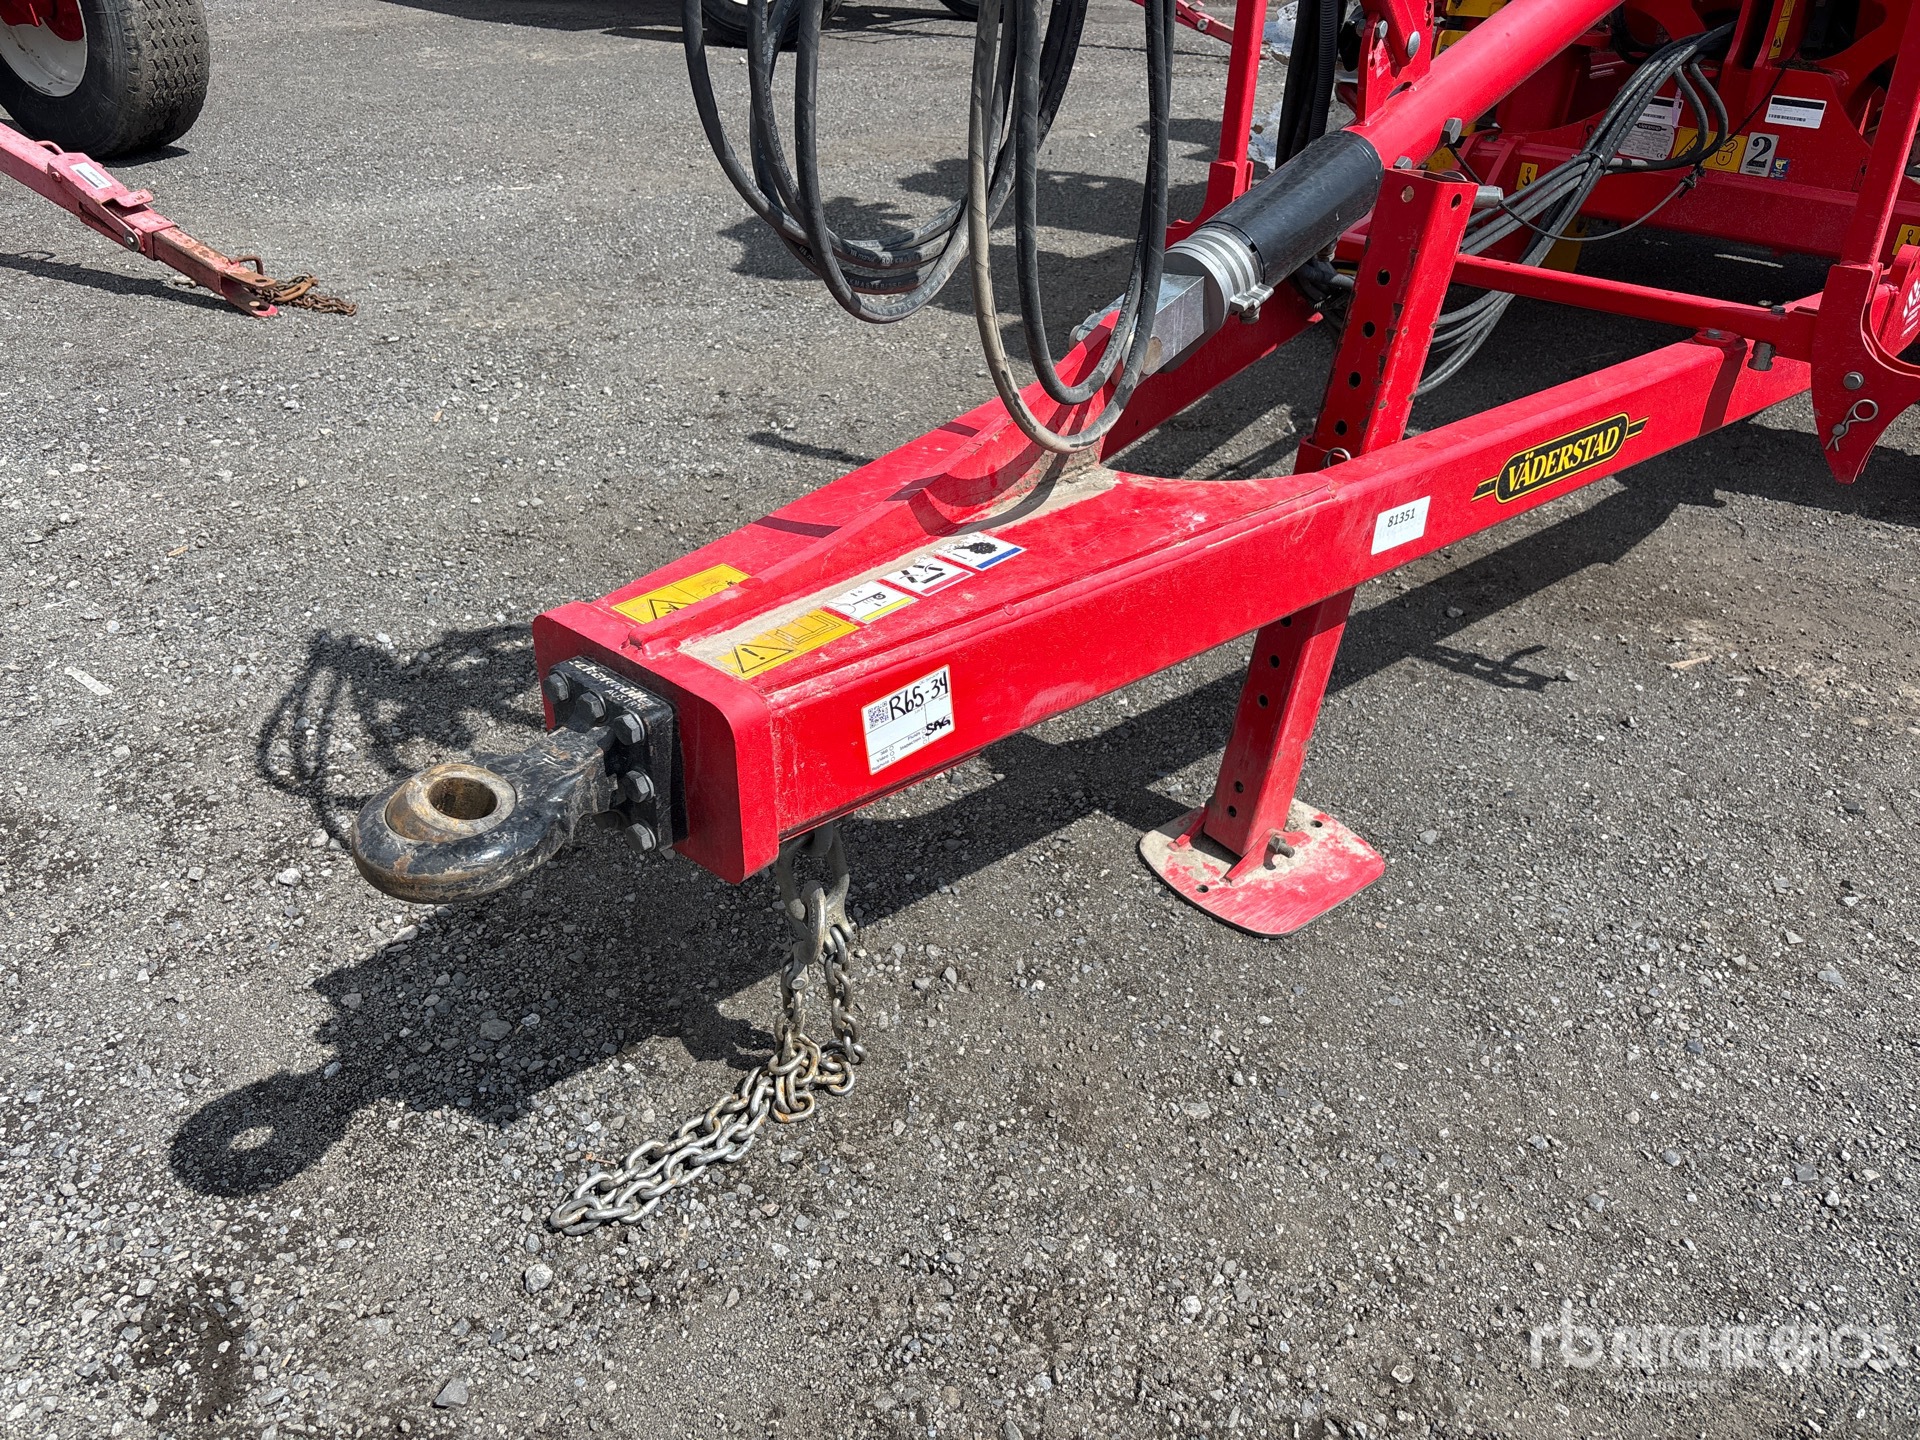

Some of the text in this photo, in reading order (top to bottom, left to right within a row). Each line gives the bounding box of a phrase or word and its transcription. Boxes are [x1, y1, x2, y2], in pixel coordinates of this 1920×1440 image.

[1747, 136, 1772, 168] 2
[1508, 426, 1621, 492] VÄDERSTAD
[1387, 507, 1416, 529] 81351
[889, 670, 949, 720] R65-34
[925, 716, 951, 736] SAG
